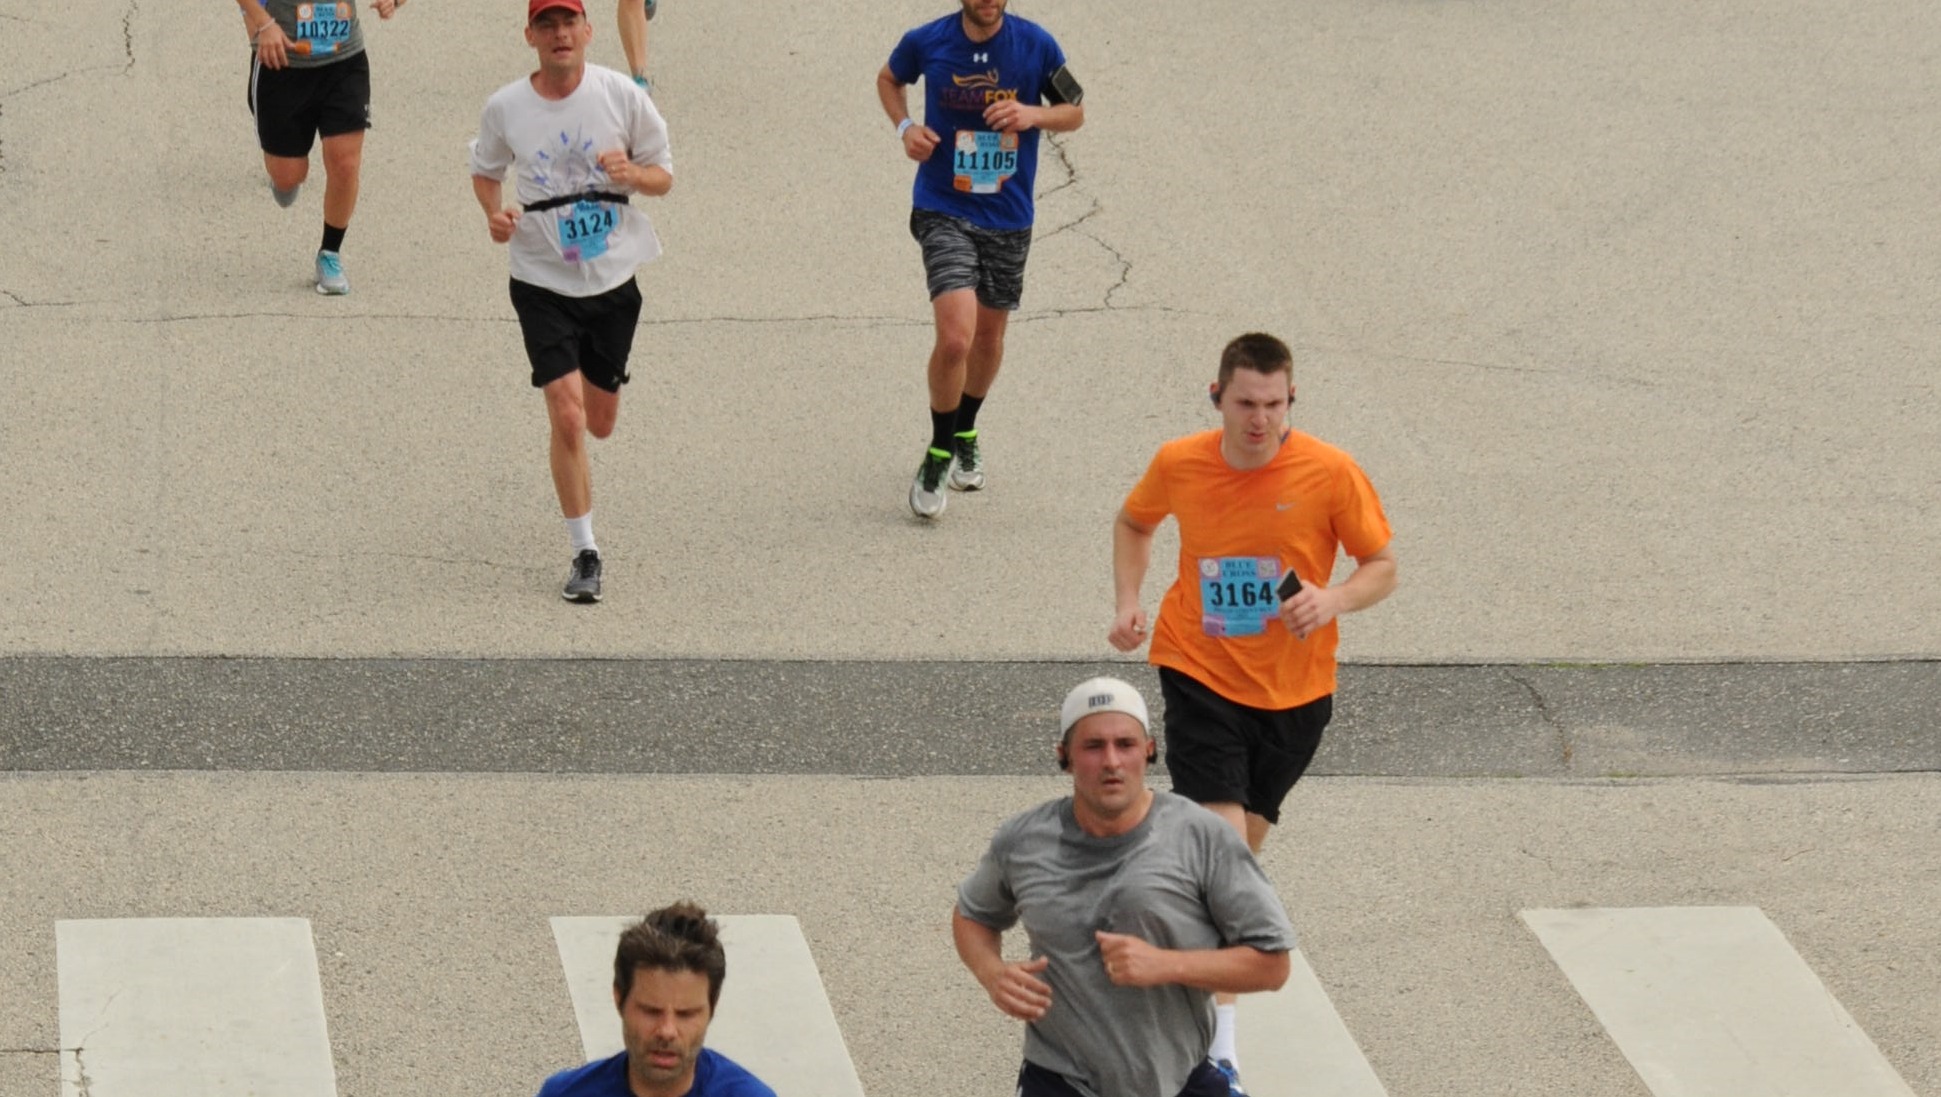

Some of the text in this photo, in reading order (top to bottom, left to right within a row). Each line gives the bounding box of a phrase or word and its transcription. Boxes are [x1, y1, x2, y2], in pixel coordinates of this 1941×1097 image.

[300, 20, 349, 39] 10322
[957, 150, 1016, 170] 11105
[565, 209, 613, 239] 3124
[1209, 581, 1274, 607] 3164
